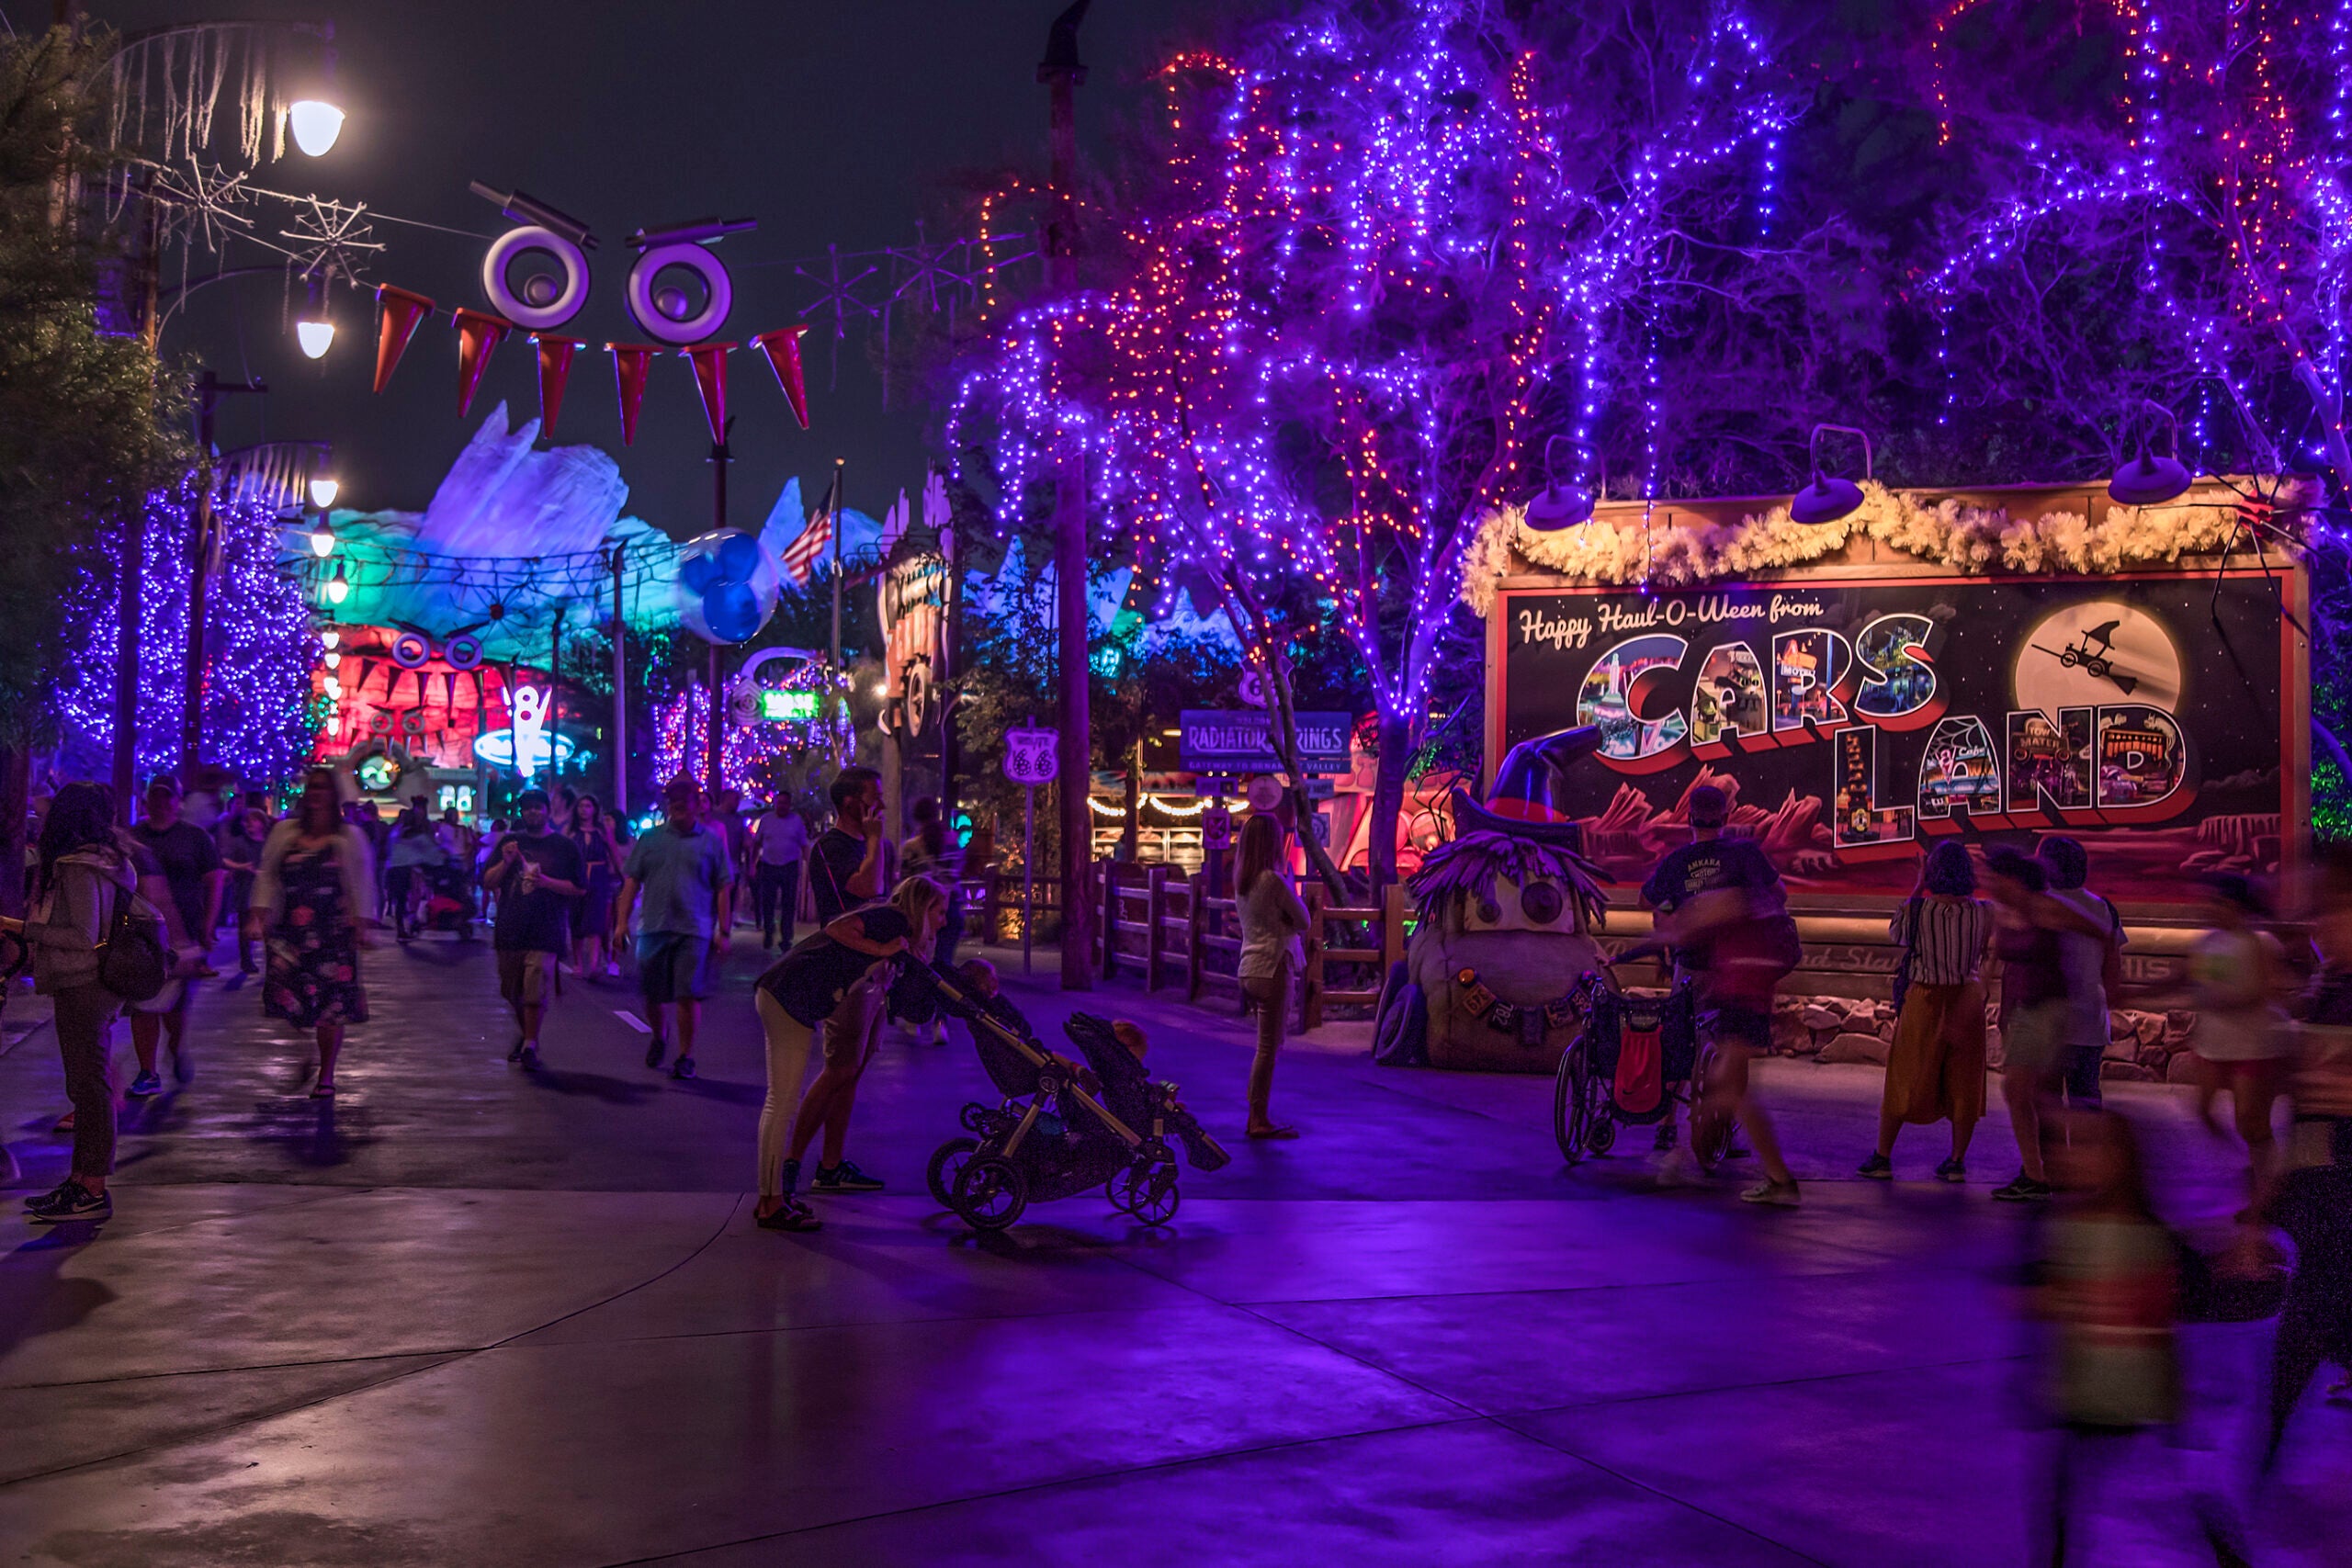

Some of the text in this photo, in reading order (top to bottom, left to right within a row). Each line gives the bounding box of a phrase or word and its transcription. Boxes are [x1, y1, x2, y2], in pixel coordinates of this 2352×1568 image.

[1520, 593, 1824, 650] Happy Haul-O-Ween from
[1577, 613, 1942, 767] CARS
[1189, 726, 1269, 752] RADIATOR
[2030, 727, 2051, 736] TOW
[1013, 748, 1053, 776] 66
[1306, 762, 1341, 772] VALLEY
[1834, 704, 2187, 852] LAND
